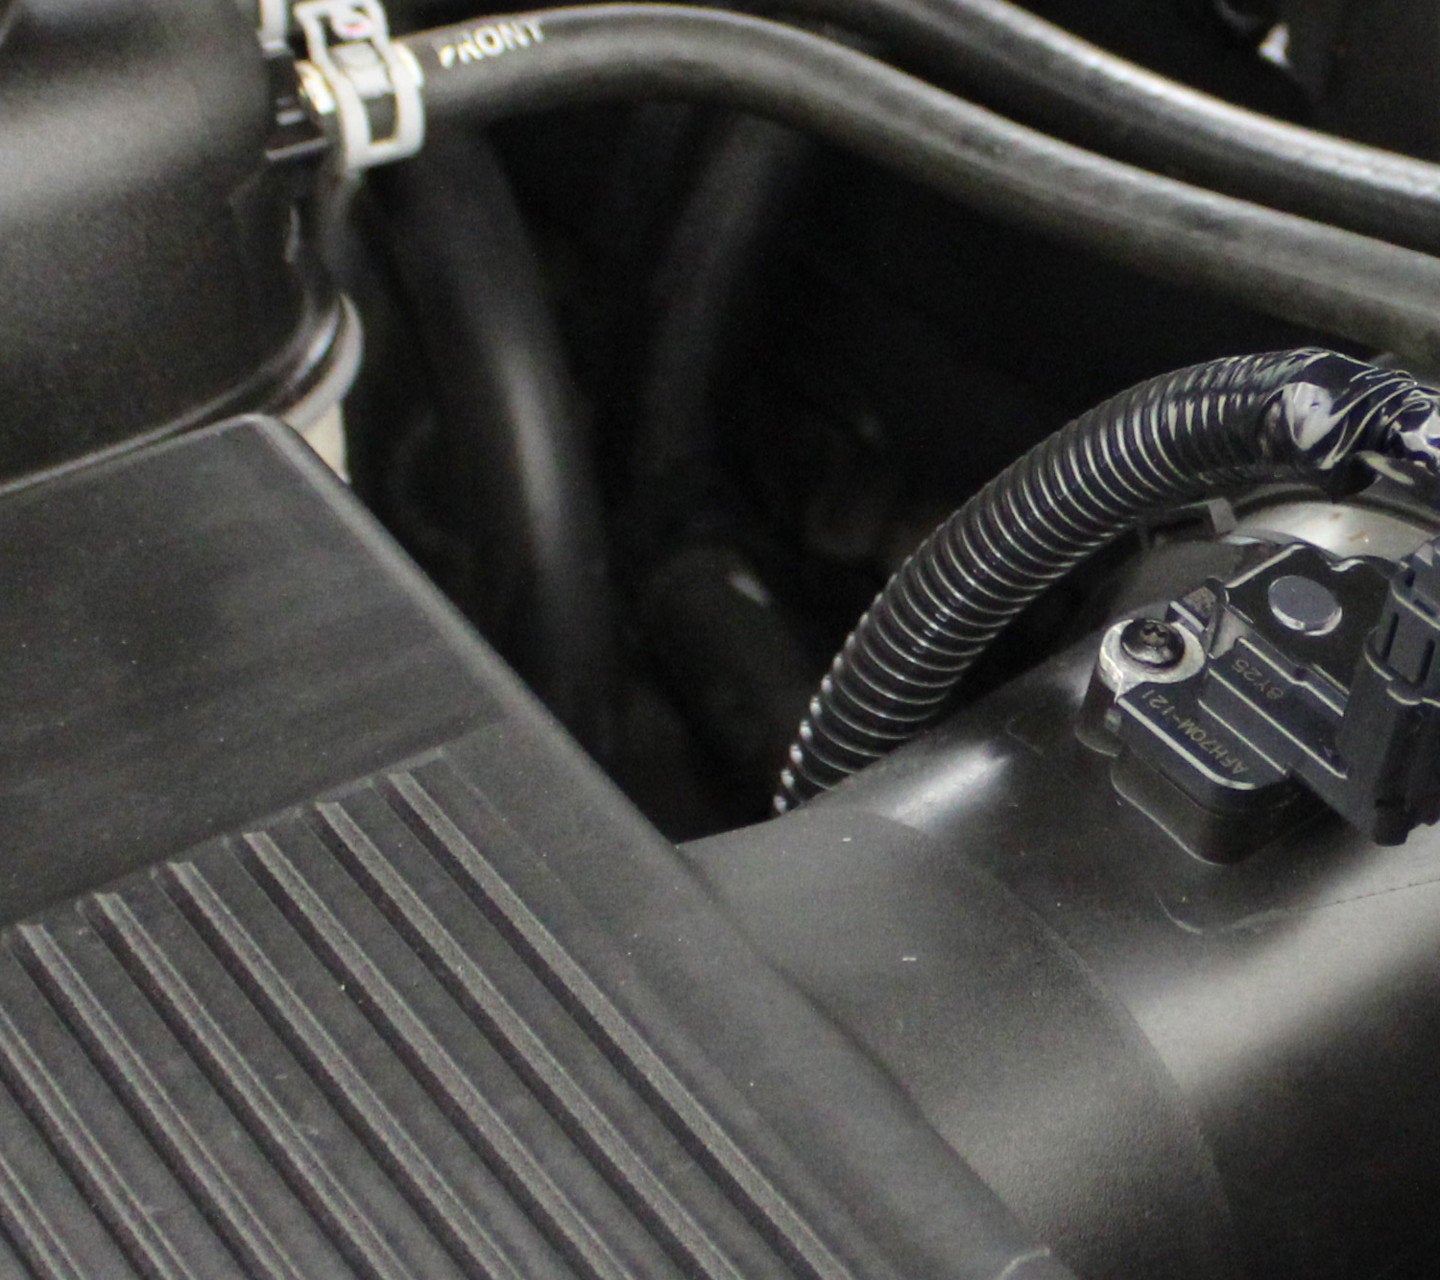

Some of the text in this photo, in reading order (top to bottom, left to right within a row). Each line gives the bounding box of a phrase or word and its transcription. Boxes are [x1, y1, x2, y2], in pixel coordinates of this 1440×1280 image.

[437, 19, 545, 67] FRONT
[1232, 658, 1284, 700] 8Y25
[1141, 688, 1250, 775] AFH70M-121
